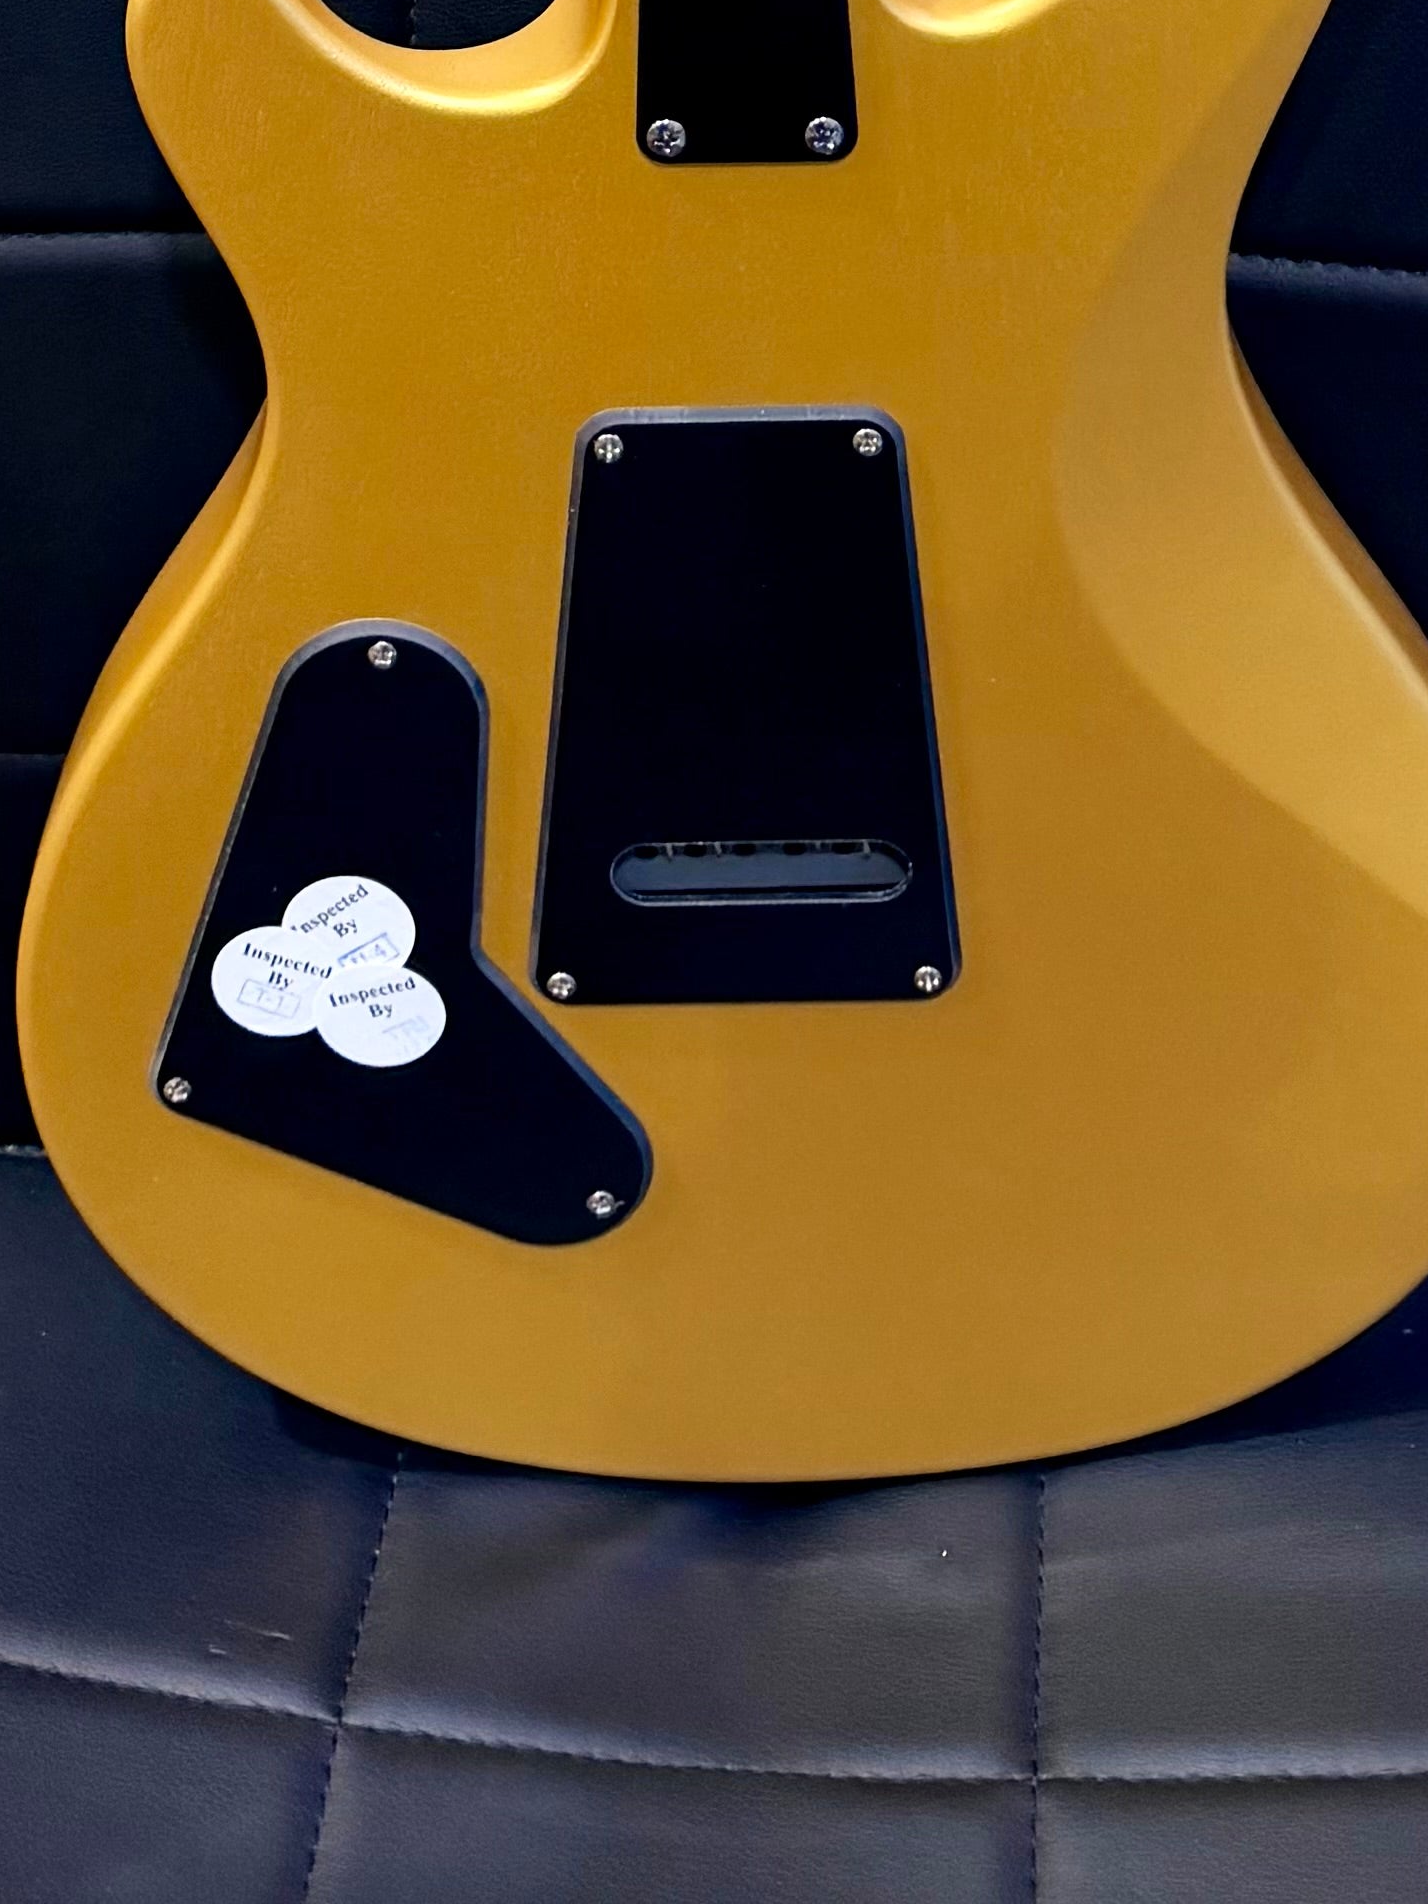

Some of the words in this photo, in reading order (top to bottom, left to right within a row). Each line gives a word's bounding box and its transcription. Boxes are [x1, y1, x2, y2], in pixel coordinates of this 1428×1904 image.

[332, 917, 359, 939] By
[242, 942, 333, 980] Inspected
[268, 971, 294, 991] By
[328, 976, 416, 1008] Inspected
[368, 1001, 395, 1019] By
